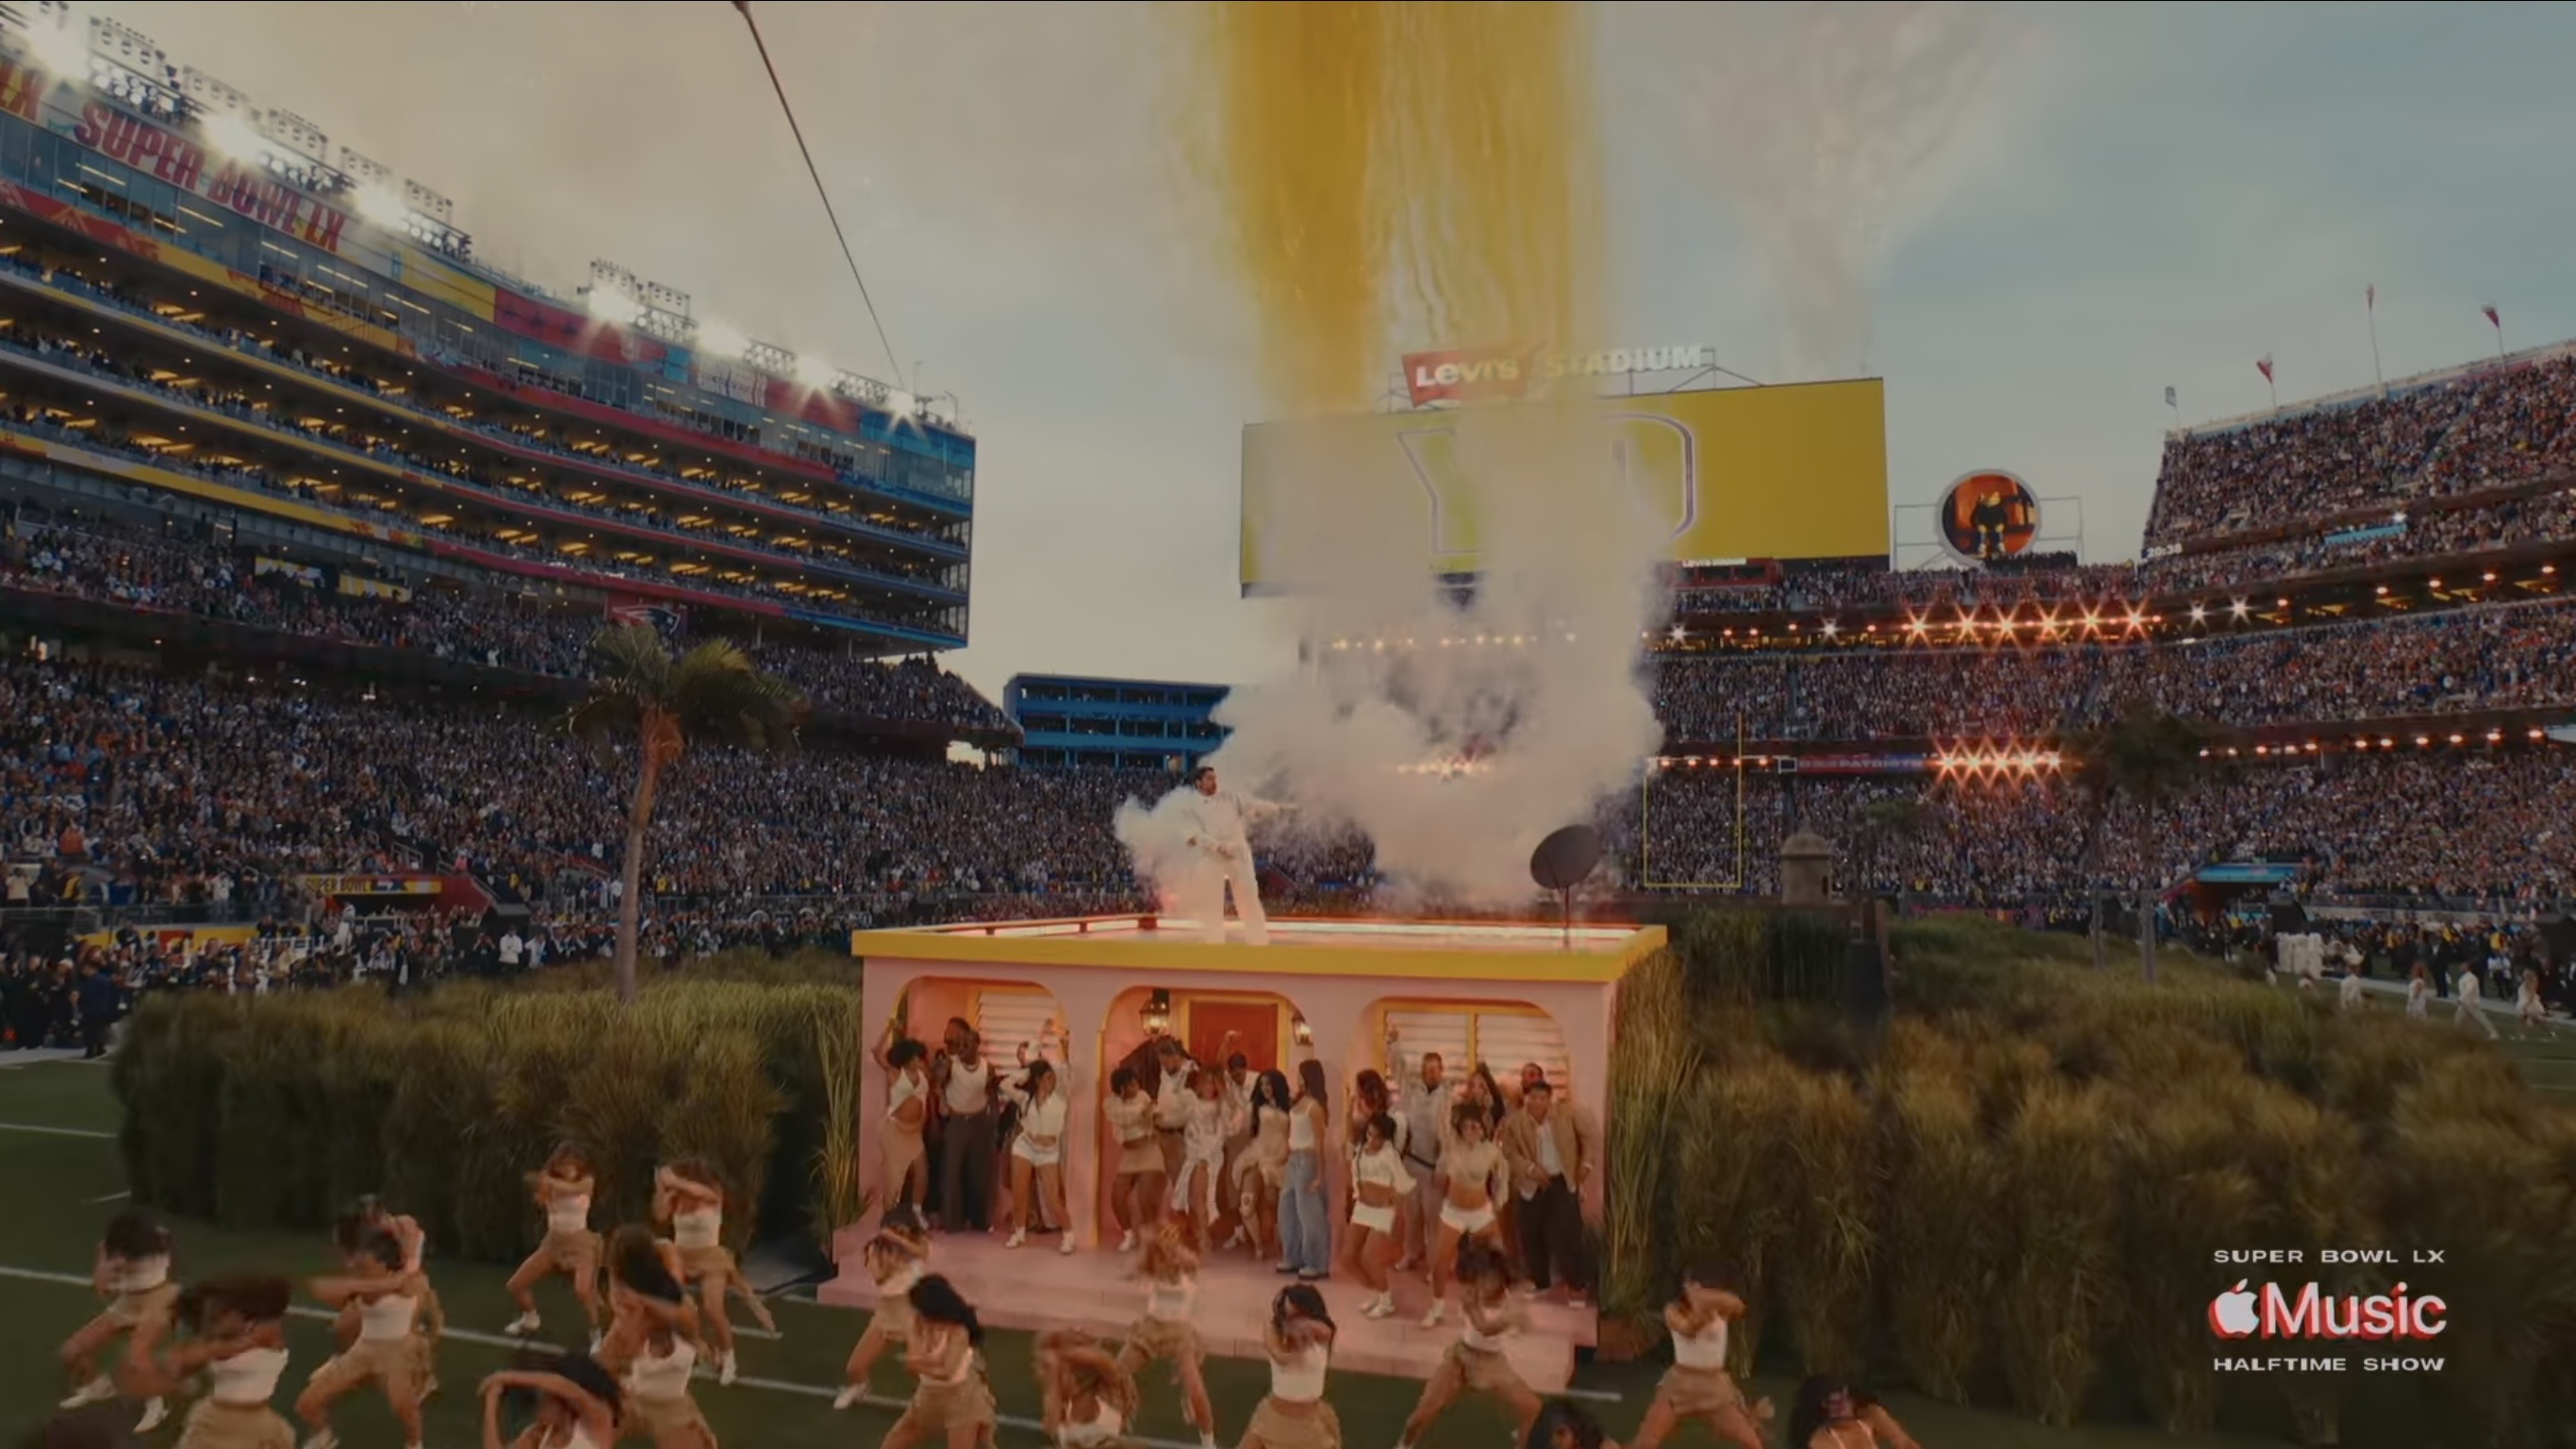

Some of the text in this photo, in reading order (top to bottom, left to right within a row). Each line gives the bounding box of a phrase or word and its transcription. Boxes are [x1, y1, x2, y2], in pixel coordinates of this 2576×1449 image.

[74, 100, 346, 253] SUPER BOWL LX
[1547, 344, 1703, 379] STADIUM
[305, 877, 338, 892] SUPER
[340, 878, 369, 893] BOWL
